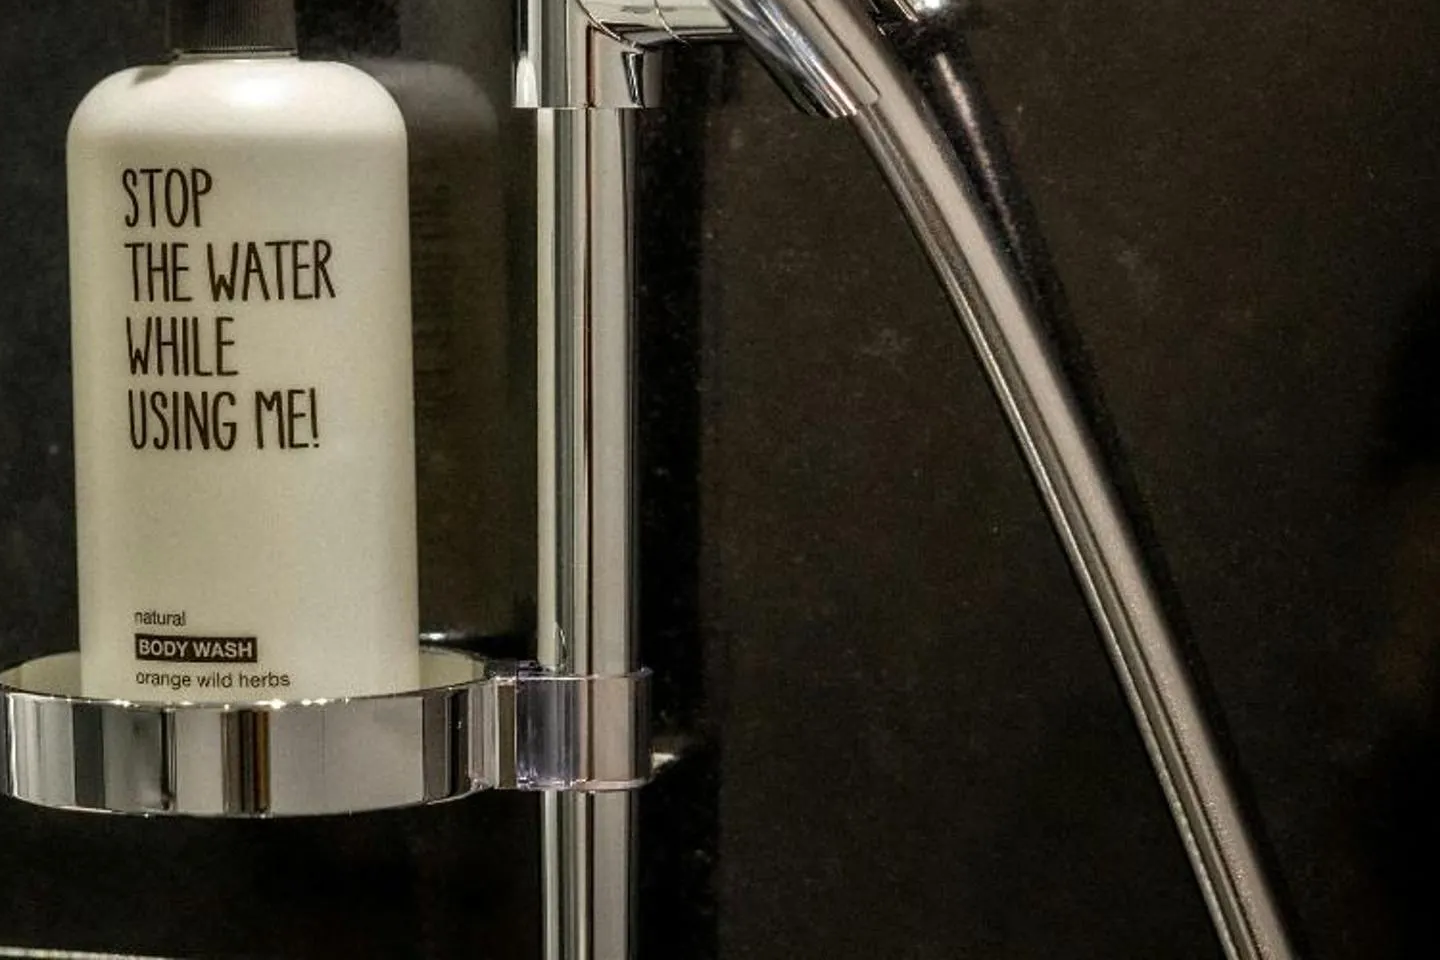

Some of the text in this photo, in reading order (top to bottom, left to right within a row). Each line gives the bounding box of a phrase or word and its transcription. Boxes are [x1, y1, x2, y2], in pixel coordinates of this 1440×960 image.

[121, 166, 214, 229] STOP
[123, 238, 337, 303] THE WATER
[125, 315, 240, 378] WHILE
[127, 387, 321, 452] USING ME!
[134, 610, 187, 627] natural
[139, 638, 253, 658] BODY WASH
[135, 671, 292, 691] orange wild herbs
